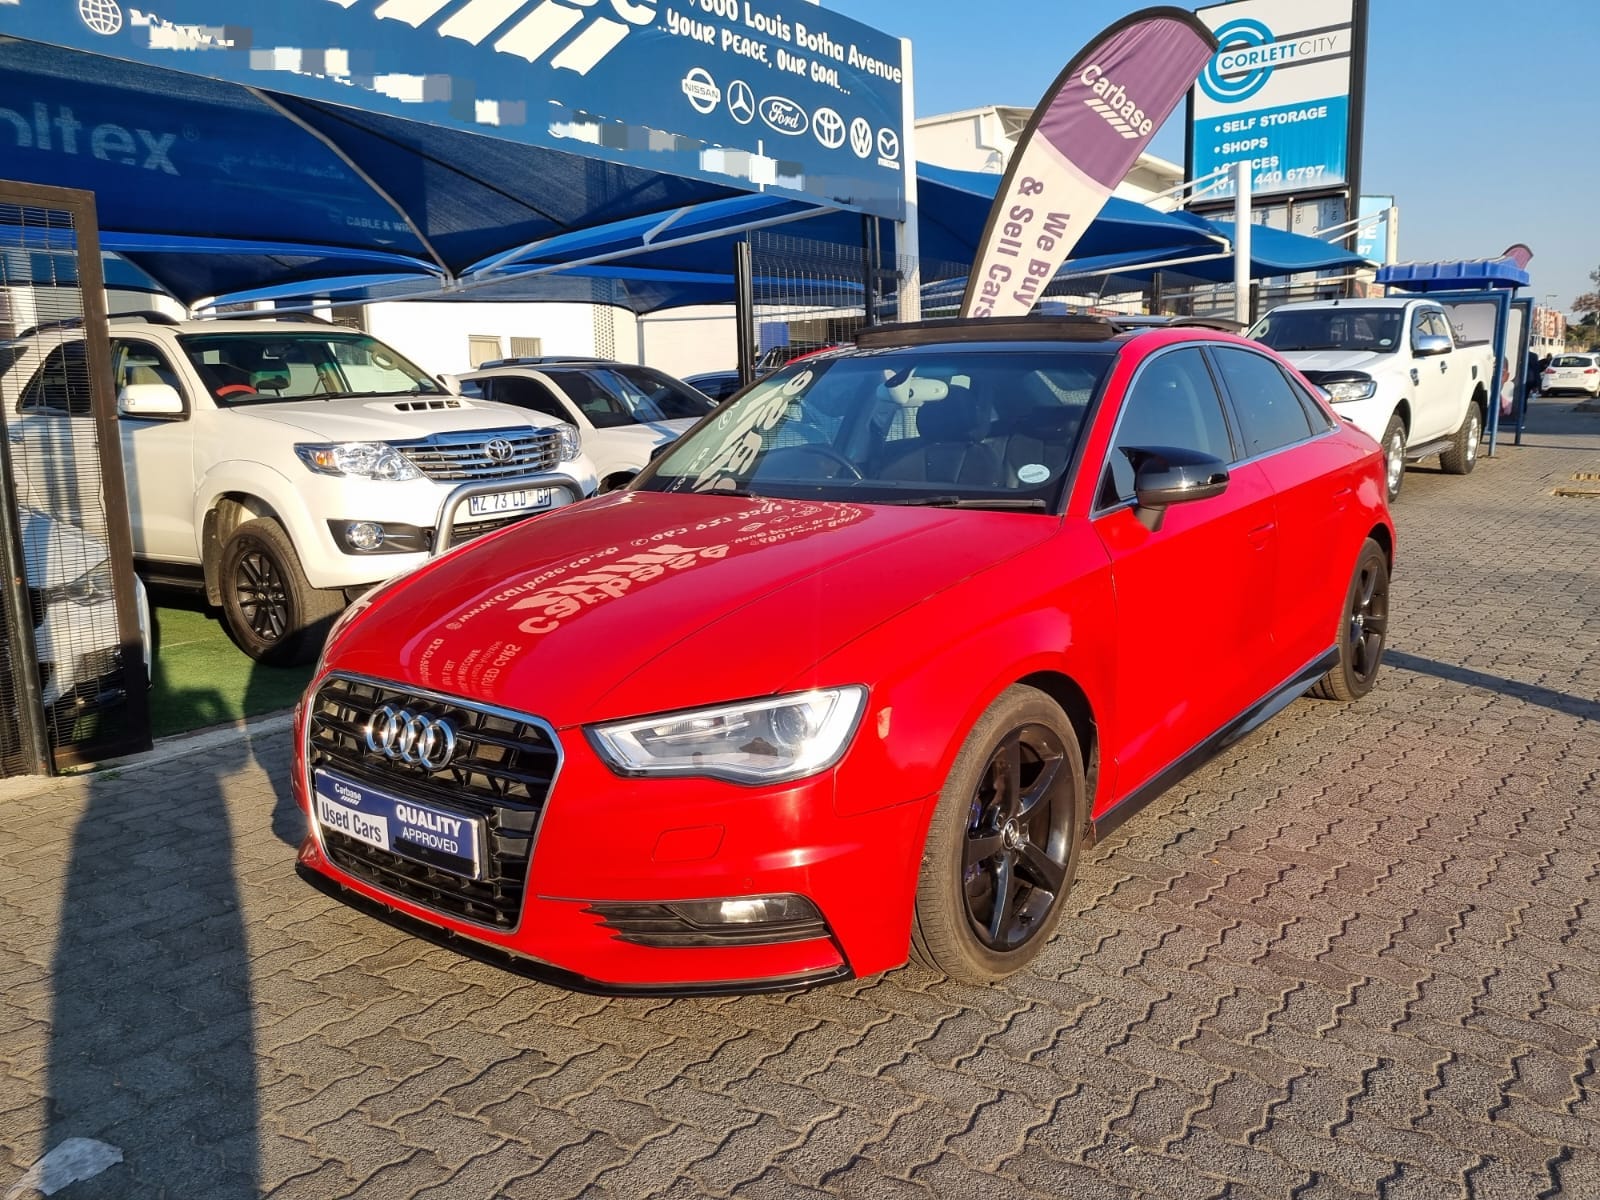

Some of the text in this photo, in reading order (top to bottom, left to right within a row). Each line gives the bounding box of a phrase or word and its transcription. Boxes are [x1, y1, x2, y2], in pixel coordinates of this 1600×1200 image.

[721, 28, 773, 69] PEACE,
[777, 49, 806, 77] OUR
[745, 1, 791, 42] Louis
[796, 22, 844, 62] Botha
[848, 44, 902, 83] Avenue
[684, 82, 719, 99] NISSAN
[1081, 64, 1153, 136] Carbase
[768, 101, 800, 129] Ford
[1222, 106, 1328, 133] SELF STORAGE
[1222, 137, 1268, 154] SHOPS
[1254, 170, 1282, 185] 440
[1287, 165, 1325, 181] 6797
[346, 215, 381, 230] CABLE
[974, 176, 1044, 317] & Sell Cars
[1013, 212, 1070, 308] We Buy
[472, 496, 487, 512] MZ
[493, 493, 507, 509] 73
[537, 487, 549, 505] GP
[334, 783, 361, 800] Carbase
[322, 801, 382, 843] Used Cars
[395, 804, 461, 838] QUALITY
[402, 827, 458, 854] APPROVED
